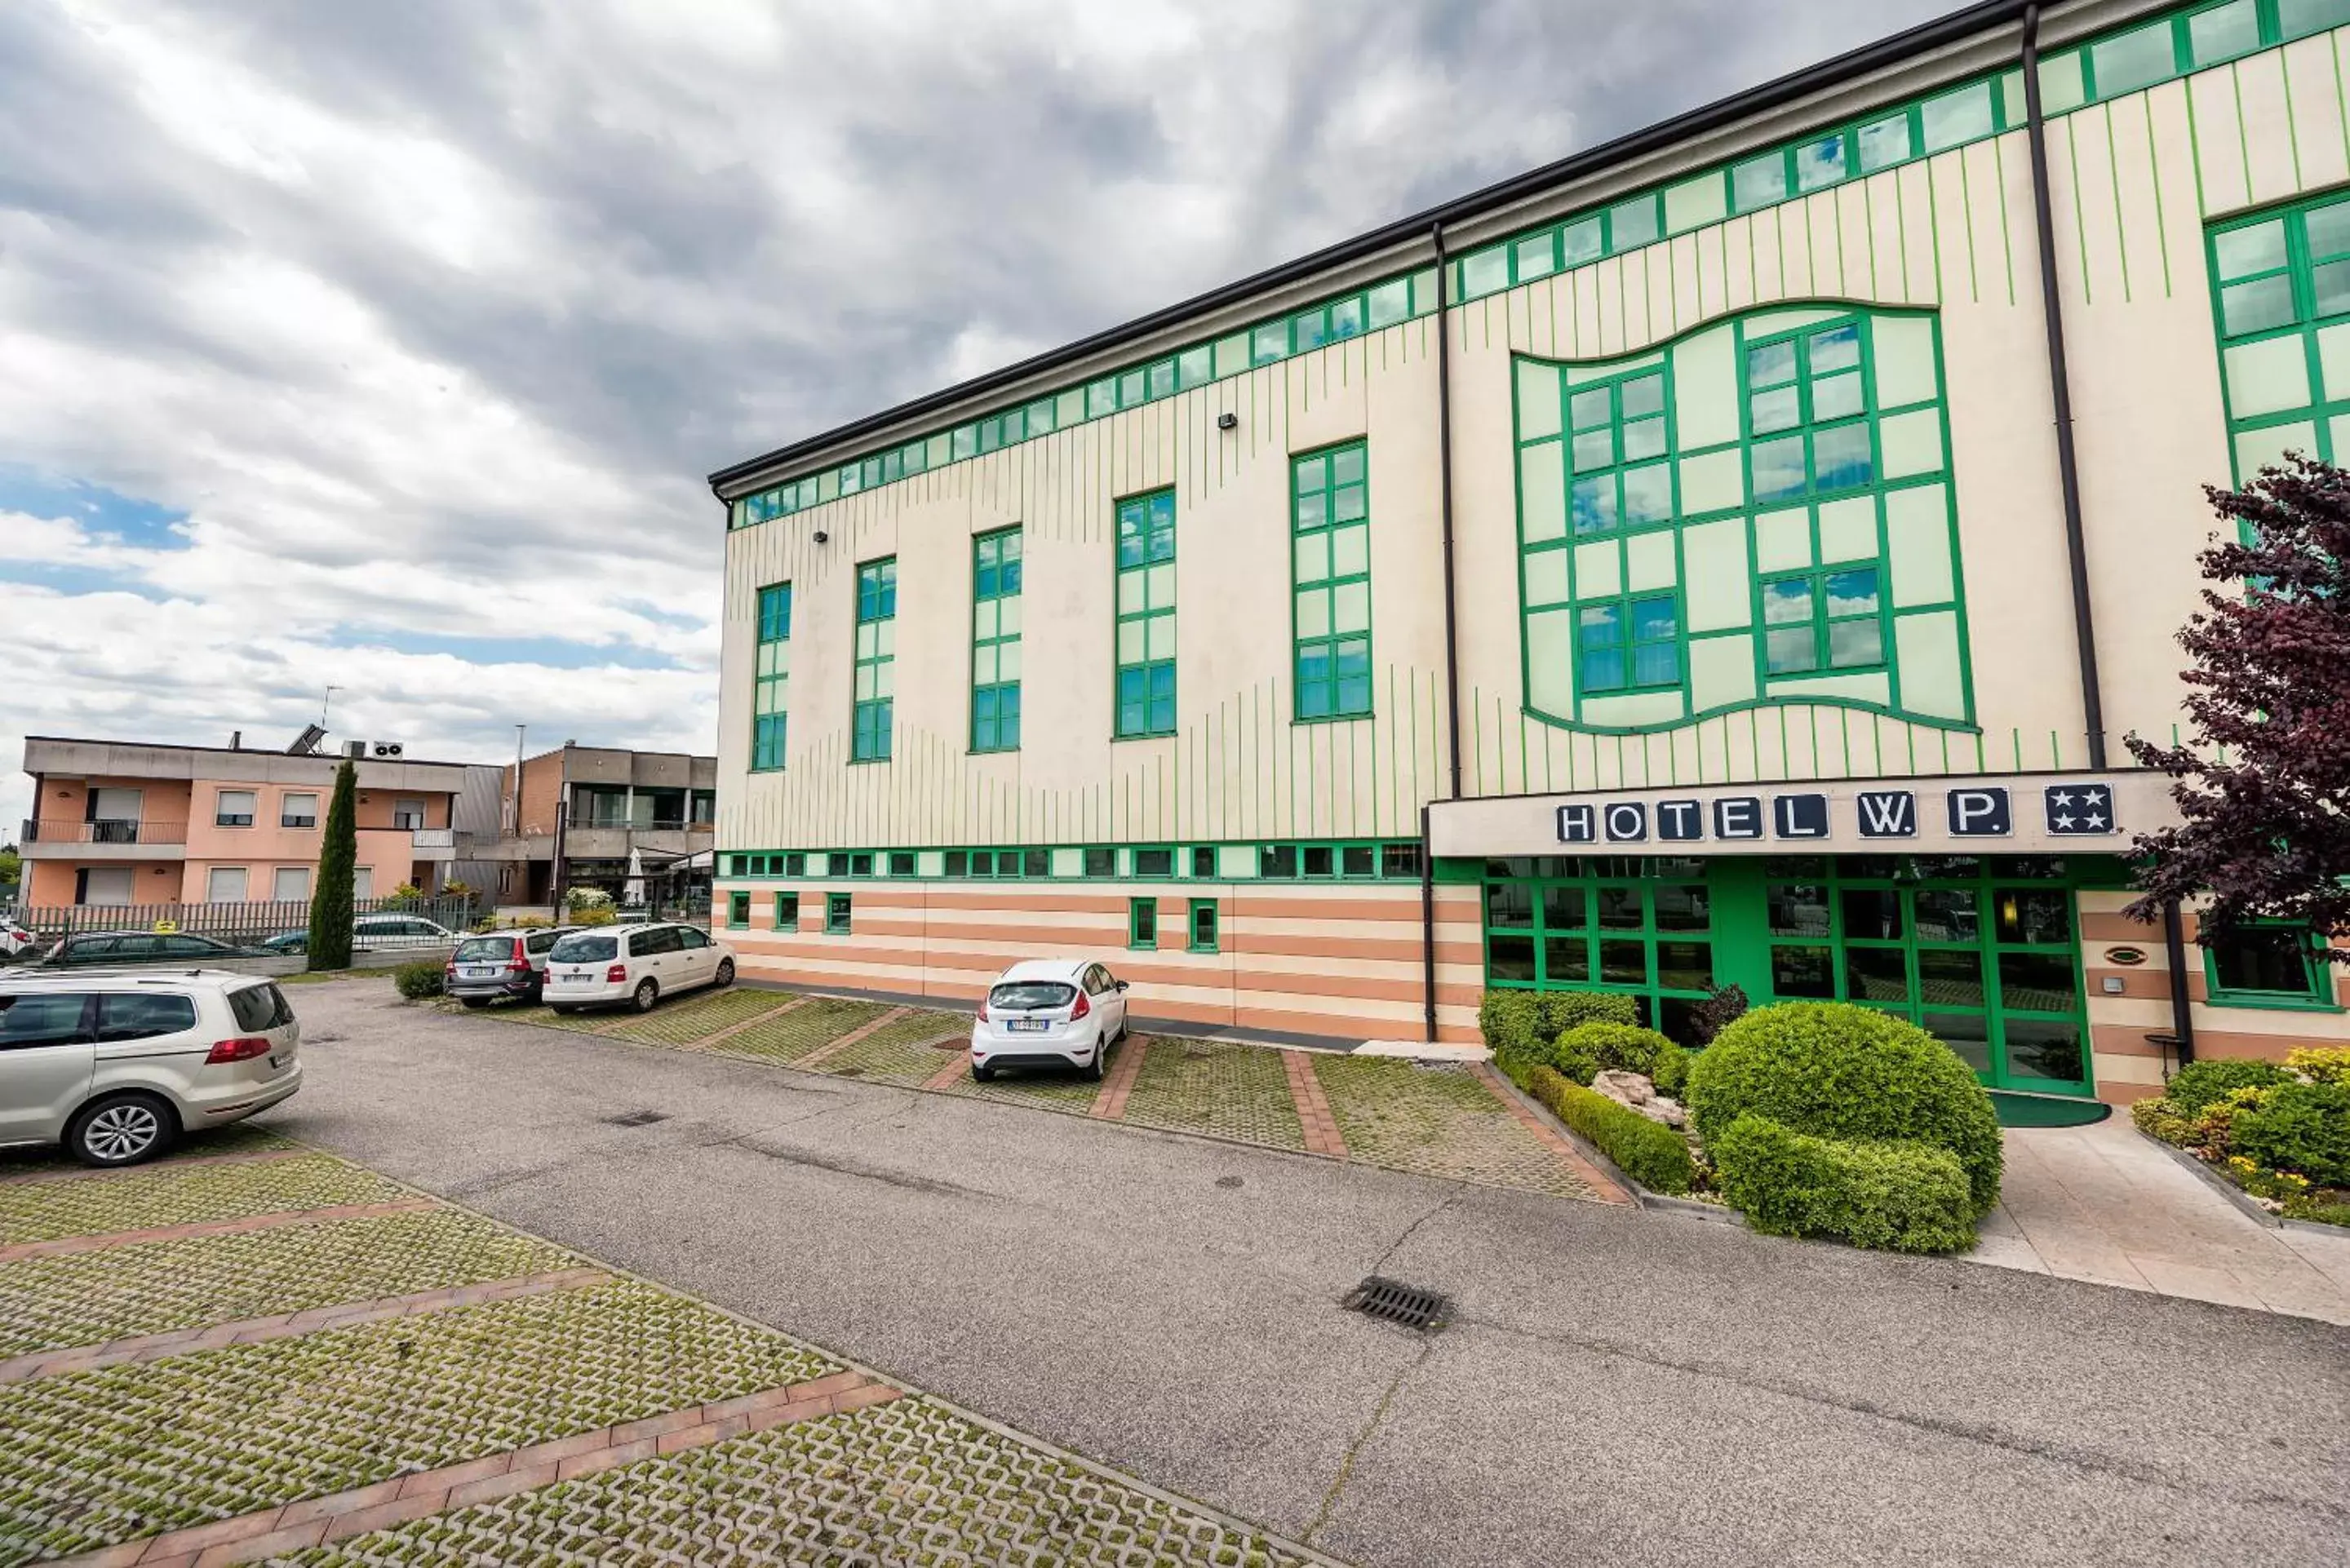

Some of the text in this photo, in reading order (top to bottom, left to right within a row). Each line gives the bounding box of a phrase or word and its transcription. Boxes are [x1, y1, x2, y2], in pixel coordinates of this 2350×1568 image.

[1563, 793, 2000, 839] HOTEL W. P.
